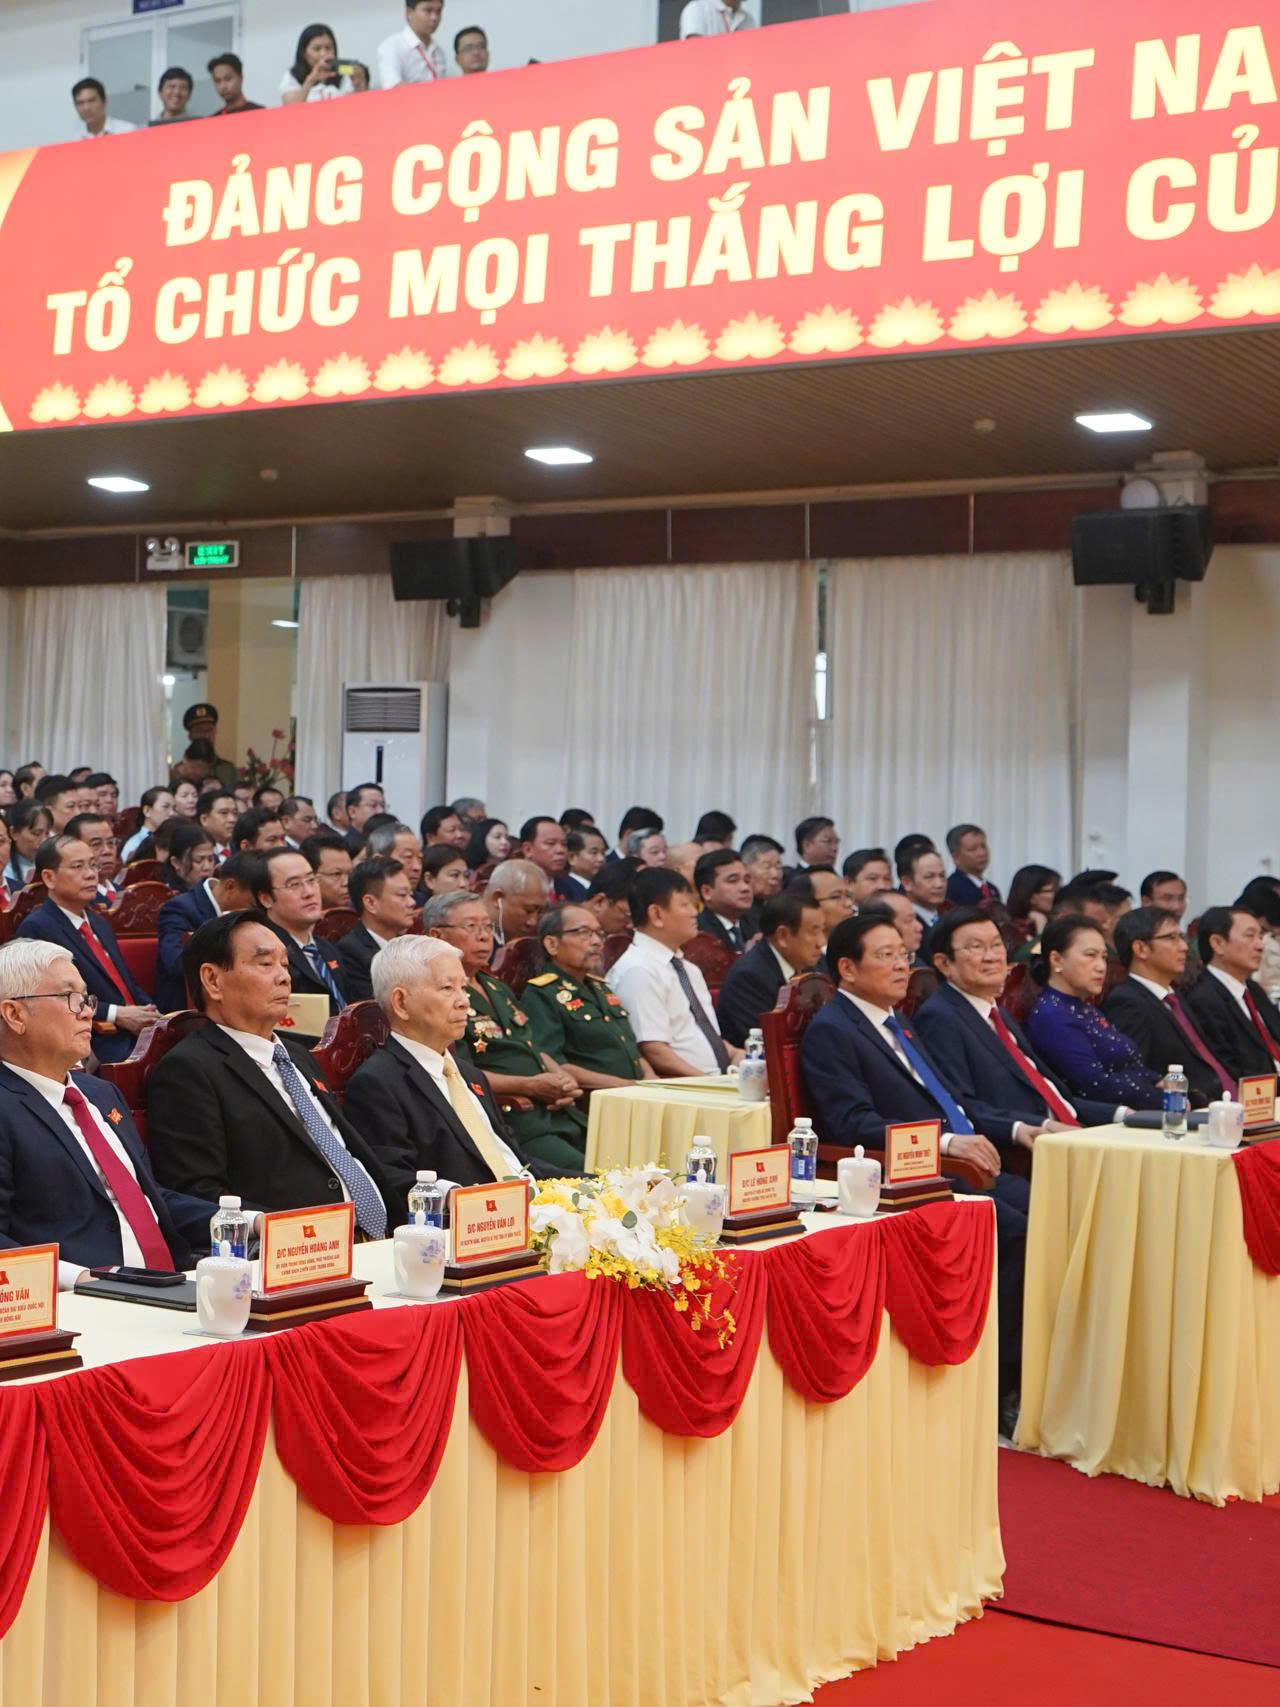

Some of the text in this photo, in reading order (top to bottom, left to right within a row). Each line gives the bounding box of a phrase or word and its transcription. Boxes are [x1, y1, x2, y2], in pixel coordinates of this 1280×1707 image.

[162, 154, 364, 247] ĐẢNG
[391, 117, 620, 224] CỘNG
[650, 77, 831, 182] SẢN
[866, 41, 1096, 157] VIỆT
[46, 256, 134, 356] TỔ
[154, 247, 361, 345] CHỨC
[388, 233, 550, 326] MỌI
[579, 182, 885, 298] THẮNG
[921, 162, 1085, 273] LỢI
